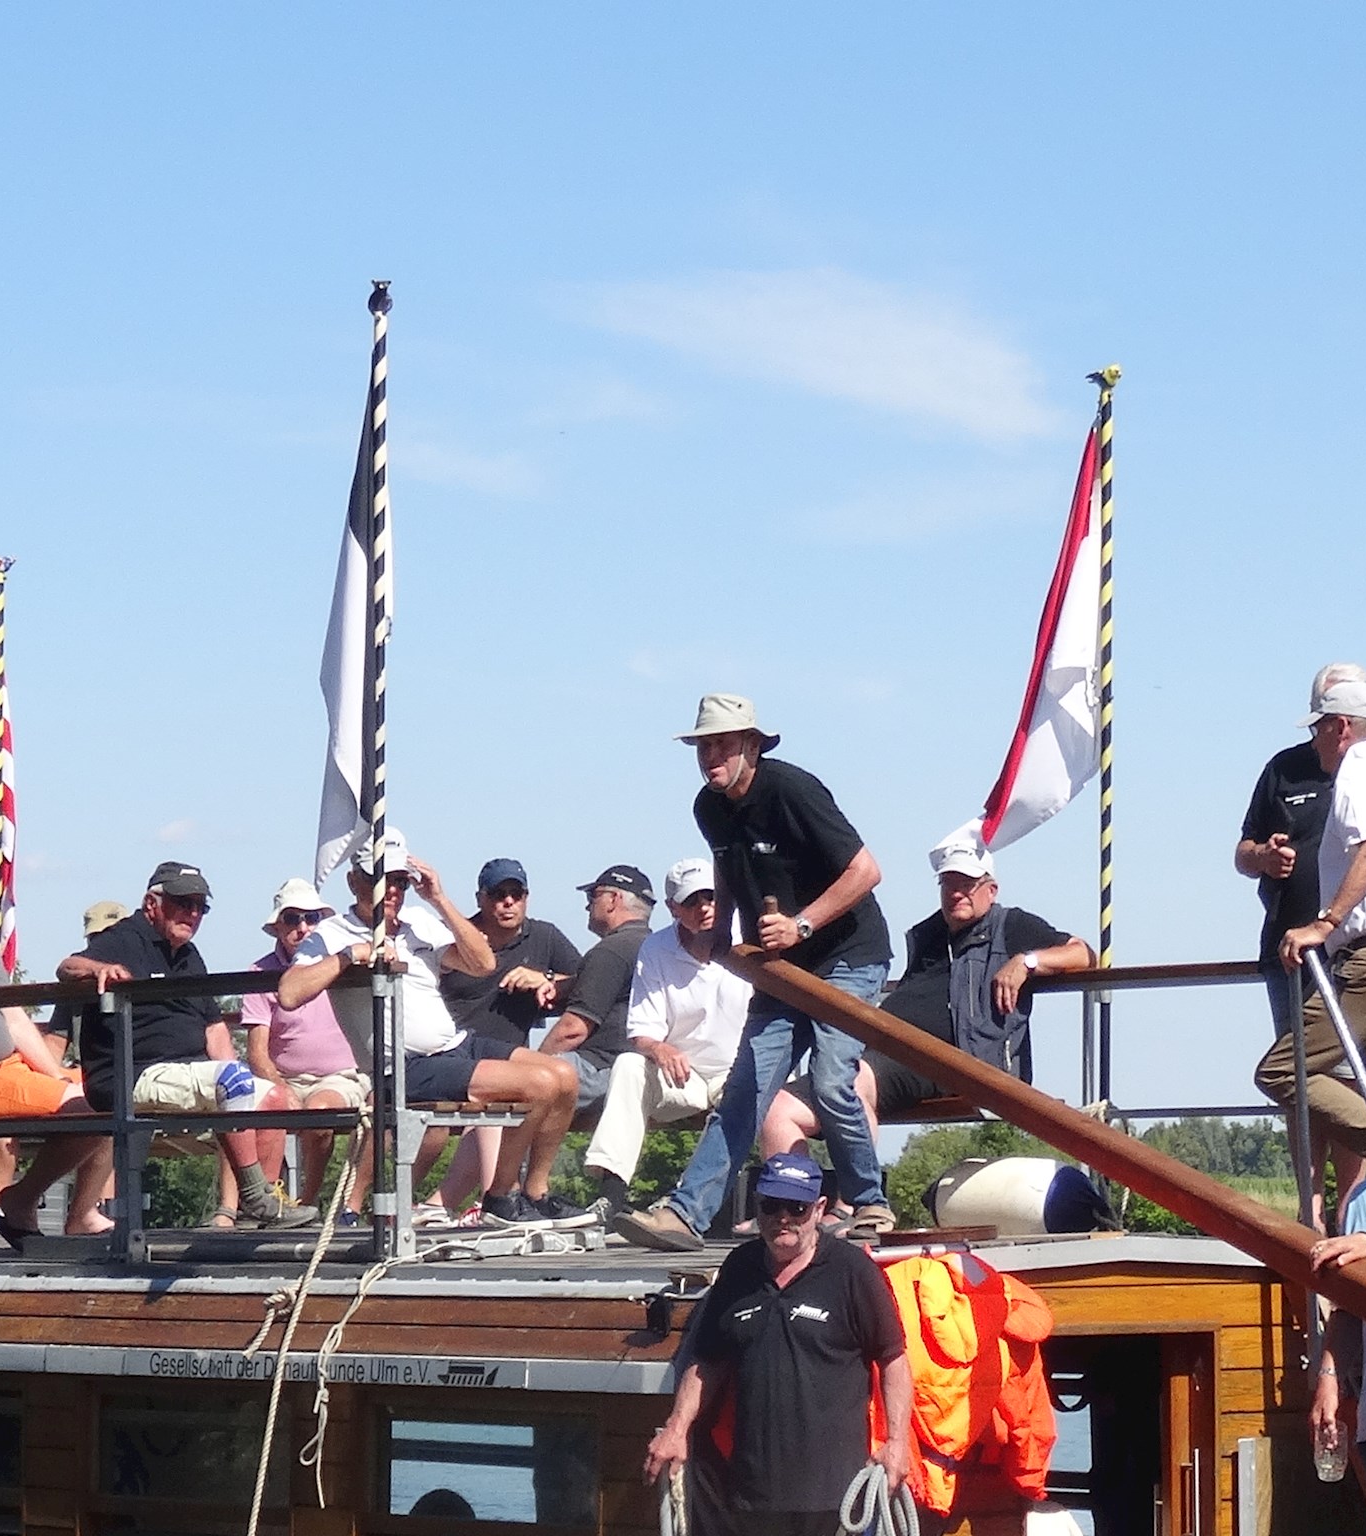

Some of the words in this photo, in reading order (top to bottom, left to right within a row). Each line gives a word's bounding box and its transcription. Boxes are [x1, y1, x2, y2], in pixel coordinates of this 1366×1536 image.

[236, 1354, 260, 1378] der
[371, 1359, 399, 1382] Ulm
[403, 1361, 432, 1383] e.V.
